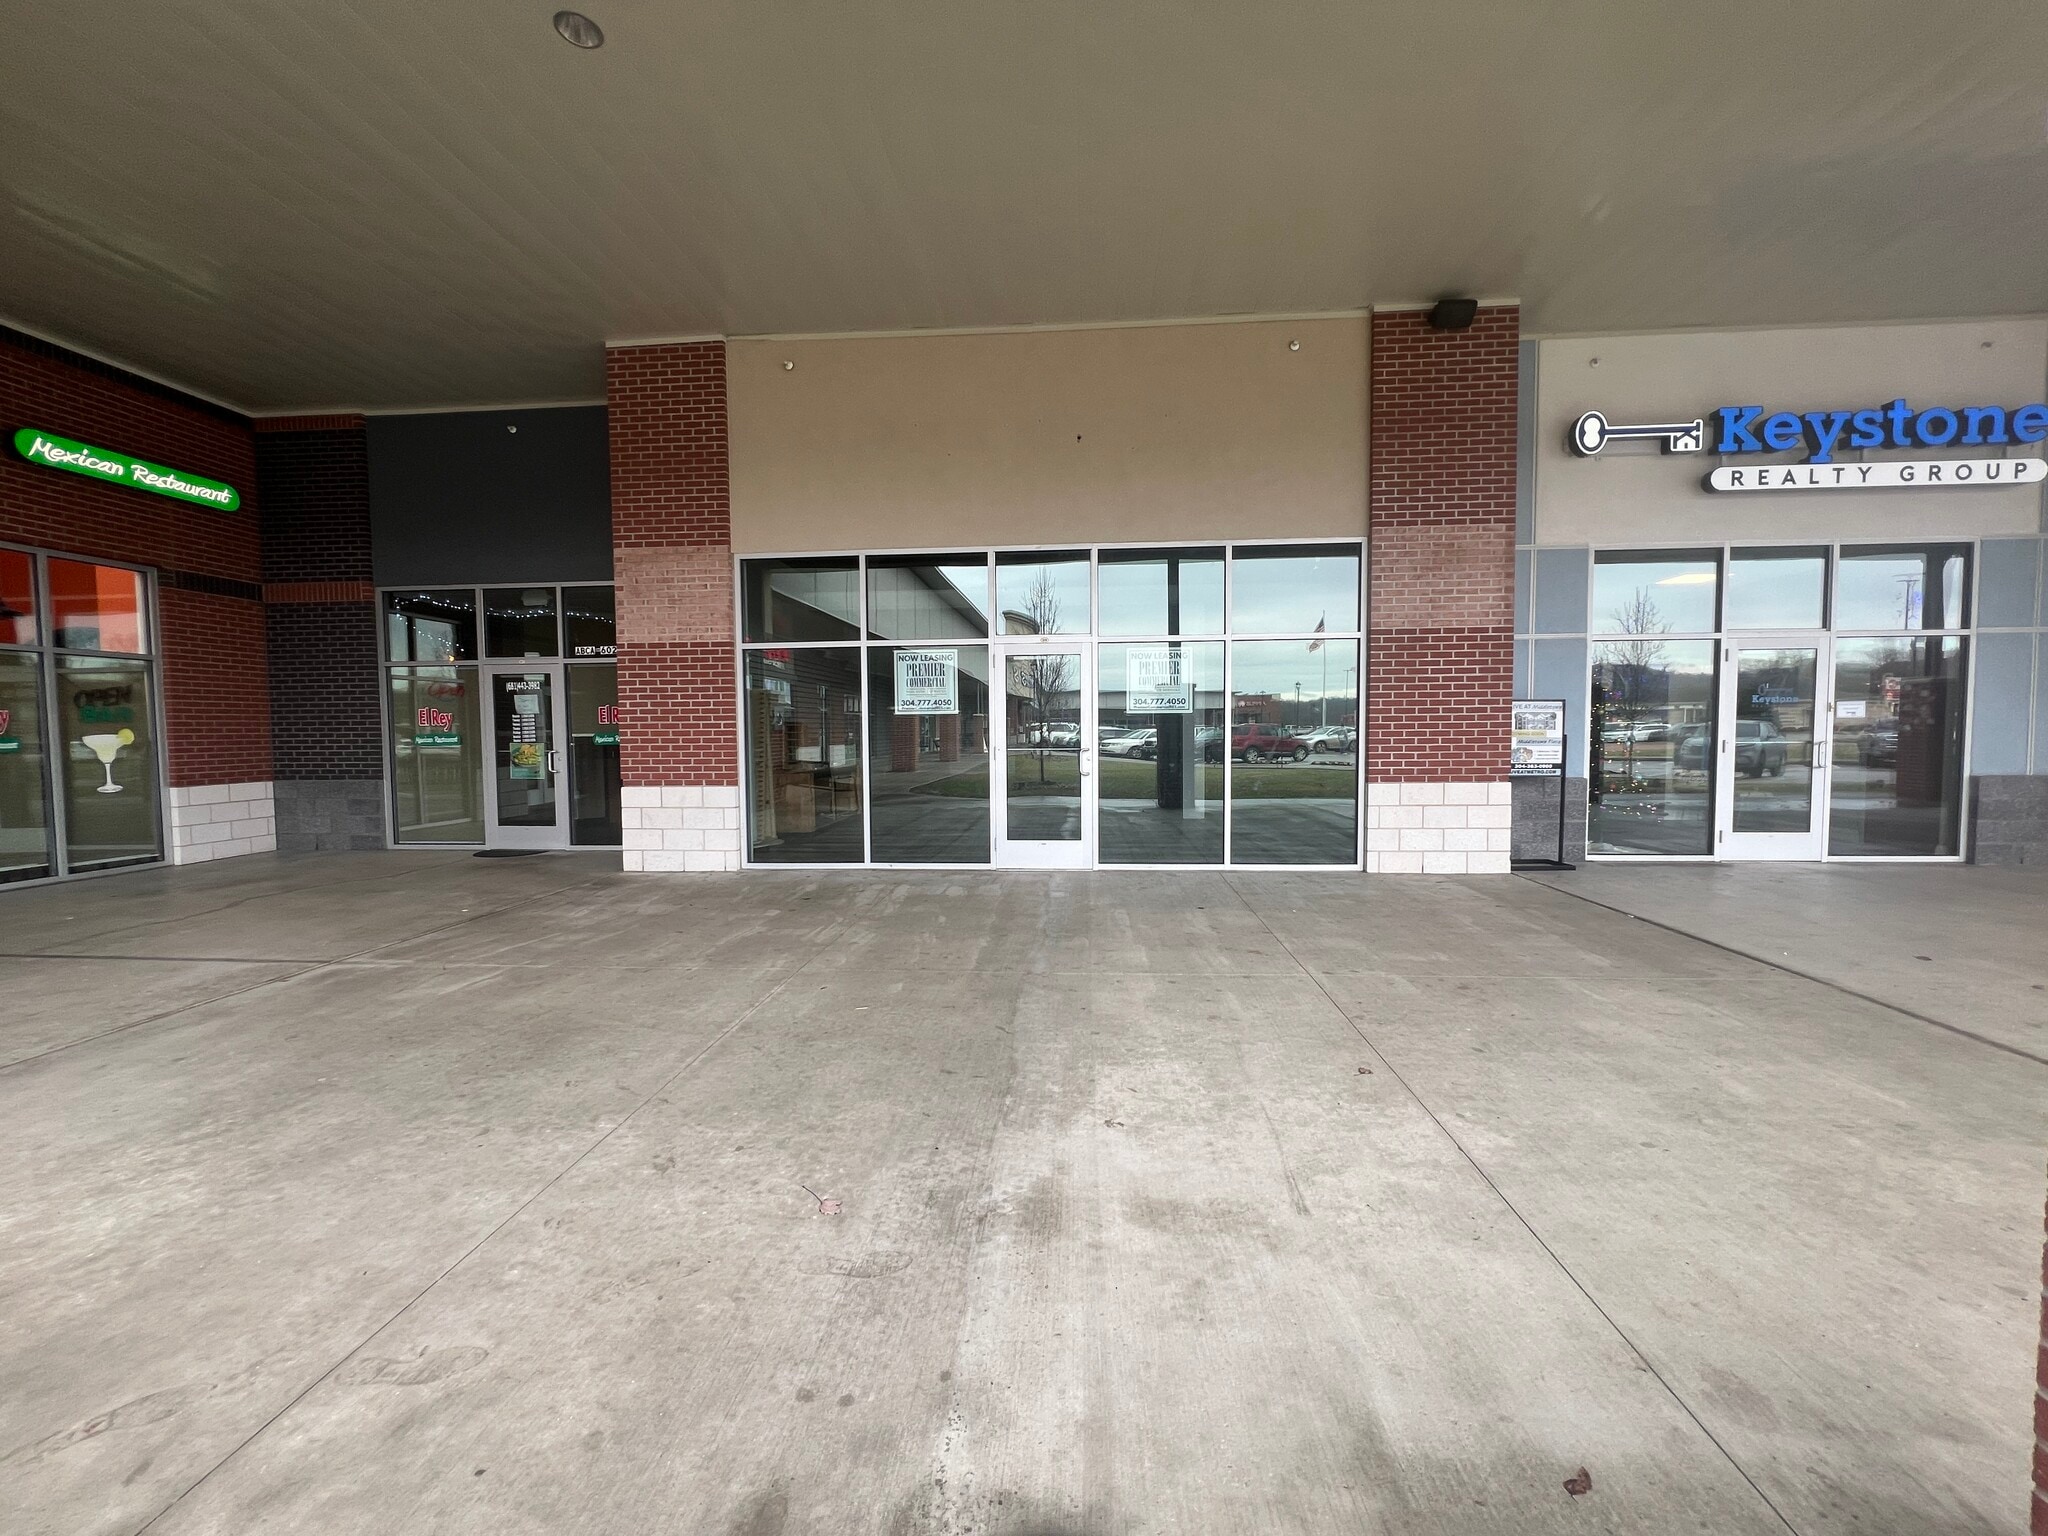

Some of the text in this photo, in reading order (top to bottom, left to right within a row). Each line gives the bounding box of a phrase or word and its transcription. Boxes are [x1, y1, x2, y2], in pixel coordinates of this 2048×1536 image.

[1718, 399, 2048, 463] Keystone
[29, 437, 232, 503] Mexican Restaurant
[1731, 463, 2027, 486] REALTY GROUP
[1131, 651, 1188, 660] NOW LEASING
[906, 663, 945, 677] PREMIER
[1139, 661, 1180, 675] PREMIER
[906, 677, 946, 688] COMMERCIAL
[1138, 675, 1180, 686] COMMERCIAL
[418, 706, 452, 732] El Rey
[598, 704, 610, 724] El
